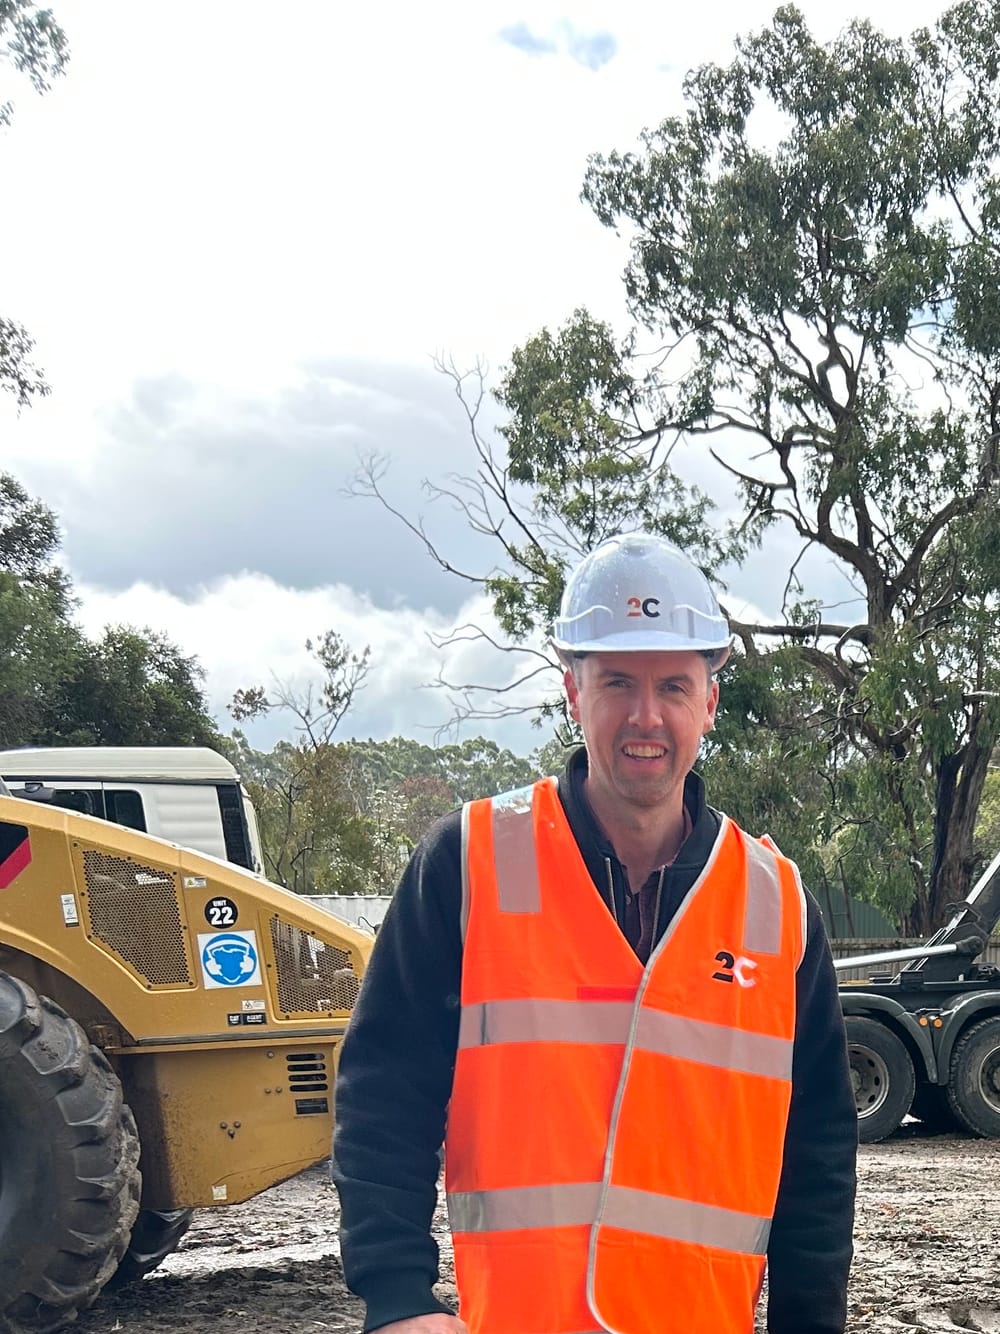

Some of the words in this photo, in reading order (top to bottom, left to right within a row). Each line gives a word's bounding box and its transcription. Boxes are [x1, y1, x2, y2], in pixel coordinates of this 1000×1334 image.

[627, 597, 661, 618] 2C
[213, 899, 227, 907] UNIT
[209, 906, 235, 926] 22
[711, 951, 758, 988] 2C
